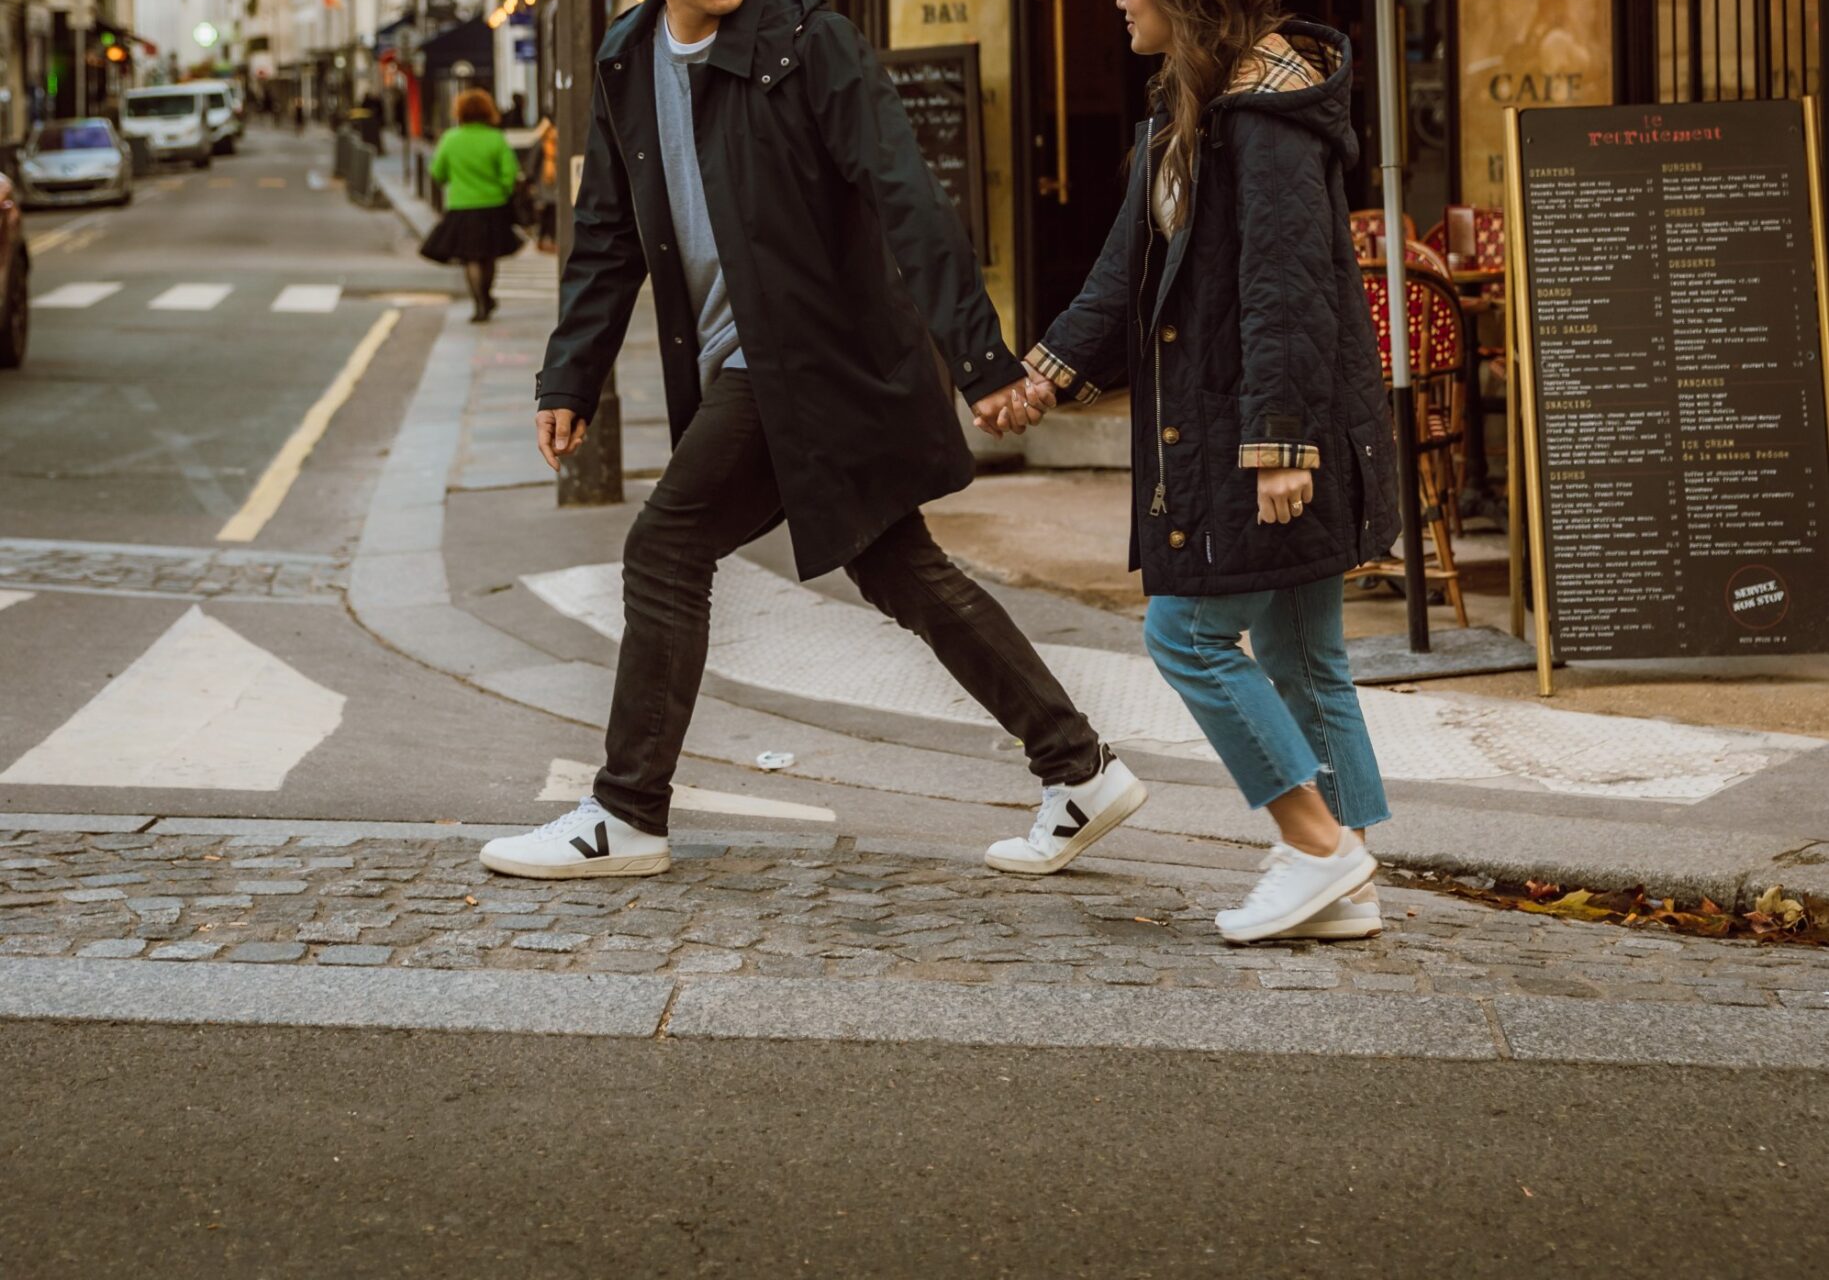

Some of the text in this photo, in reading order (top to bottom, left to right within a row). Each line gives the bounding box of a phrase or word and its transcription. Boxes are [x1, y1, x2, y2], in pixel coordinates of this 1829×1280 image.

[921, 2, 968, 24] BAR
[1528, 167, 1574, 177] STARTERS
[1661, 162, 1702, 172] BURGERS
[1664, 207, 1705, 217] CHEESES
[1668, 258, 1715, 268] DESSERTS
[1536, 287, 1572, 297] BOARDS
[1539, 323, 1597, 335] BIG SALADS
[1677, 377, 1724, 387] PANCAKES
[1544, 399, 1591, 409] SNACKING
[1681, 438, 1734, 449] ICE CREAM
[1682, 452, 1693, 461] de
[1699, 452, 1710, 460] la
[1715, 450, 1750, 460] maison
[1549, 470, 1585, 480] DISHES
[1733, 580, 1778, 600] SERVICE
[1733, 591, 1785, 613] NON STOP
